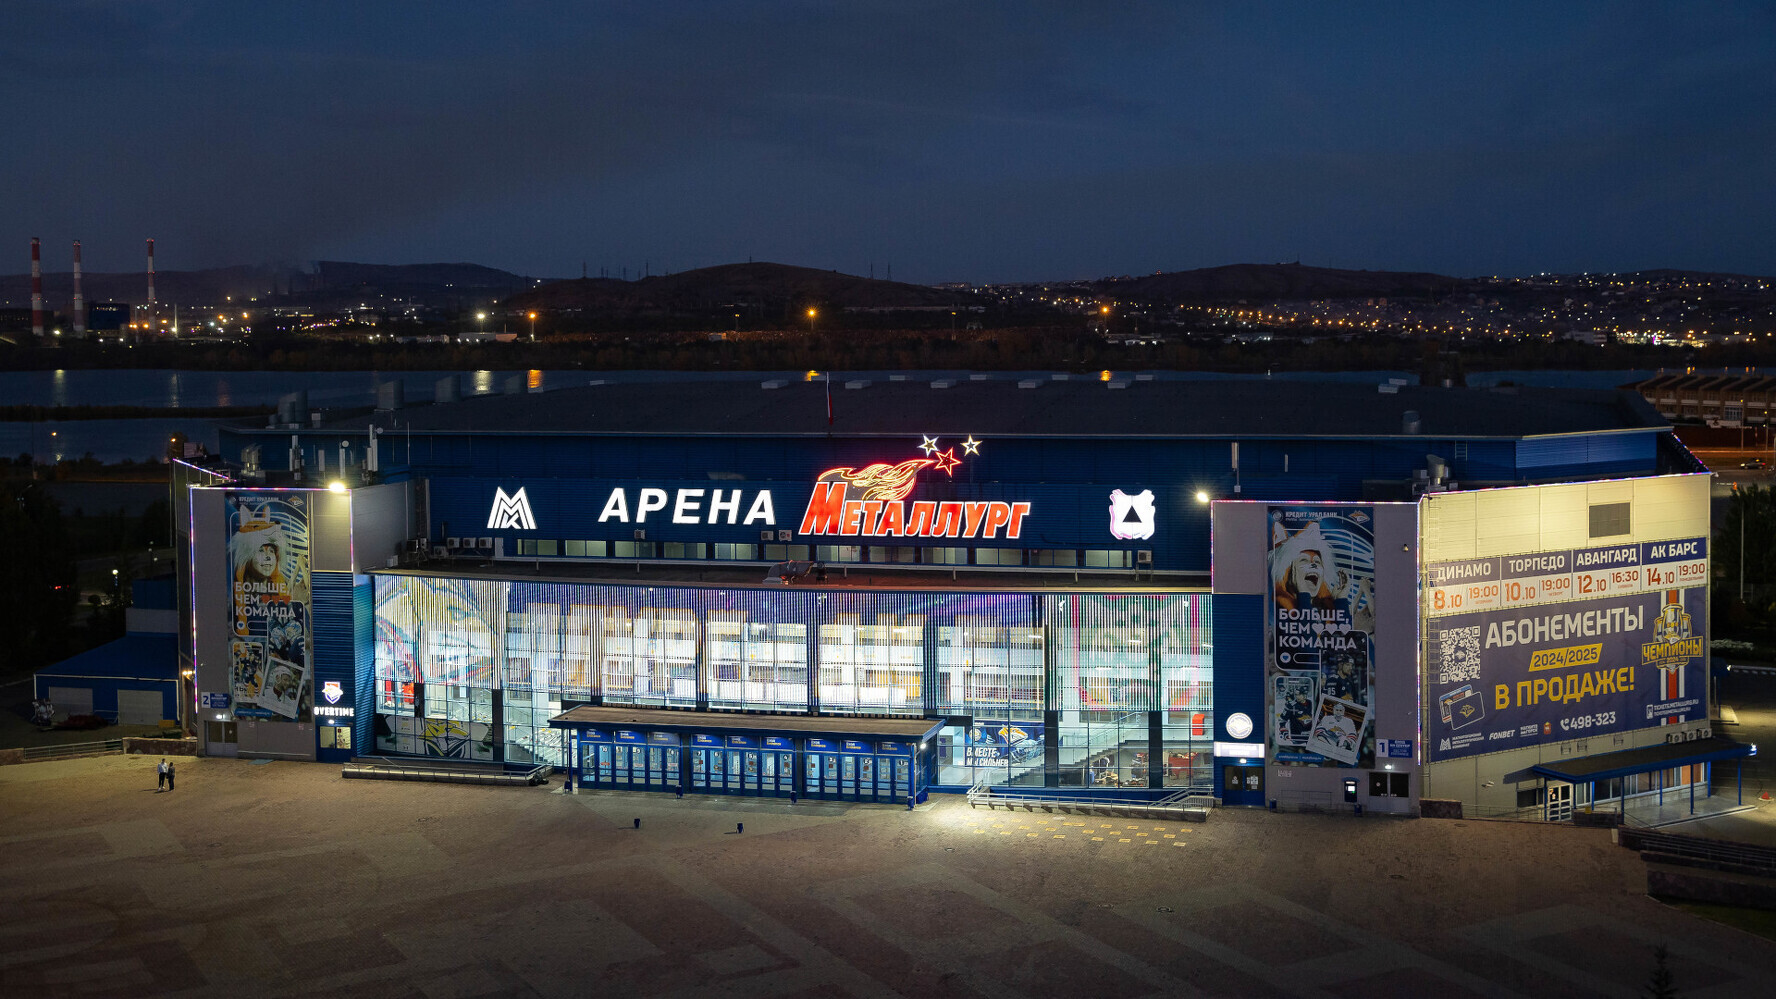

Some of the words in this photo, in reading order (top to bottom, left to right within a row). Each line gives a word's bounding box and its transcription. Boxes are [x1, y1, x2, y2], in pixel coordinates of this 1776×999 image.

[598, 487, 776, 525] АРЕНА
[798, 482, 1031, 539] МЕТАЛЛУРГ
[1576, 548, 1637, 566] АВАНГАРД
[1651, 545, 1666, 559] АК
[1668, 542, 1698, 557] БАРС
[1436, 563, 1491, 582] ДИНАМО
[1508, 555, 1565, 573] ТОРПЕДО
[1577, 575, 1606, 594] 12.10
[1612, 570, 1639, 583] 16:30
[1646, 568, 1674, 586] 14.10
[1679, 563, 1705, 576] 19:00
[1434, 590, 1462, 610] 8.10
[1469, 585, 1498, 599] 19:00
[1505, 582, 1536, 601] 10.10
[1541, 578, 1570, 591] 19:00
[235, 594, 260, 605] ЧЕМ
[235, 606, 296, 619] КОМАНДА
[1278, 622, 1310, 634] ЧЕМ
[1485, 605, 1643, 649] АБОНЕМЕНТЫ
[1279, 635, 1357, 650] КОМАНДА
[1643, 638, 1702, 662] ЧЕМПИОНЫ
[1533, 647, 1598, 667] 2024/2025
[1495, 684, 1510, 710] В
[1517, 666, 1634, 708] ПРОДАЖЕ!
[203, 695, 209, 705] 2
[313, 706, 354, 717] OVERTIME
[1570, 711, 1616, 729] 498-323
[1489, 729, 1515, 740] FONBET
[1379, 742, 1385, 753] 1
